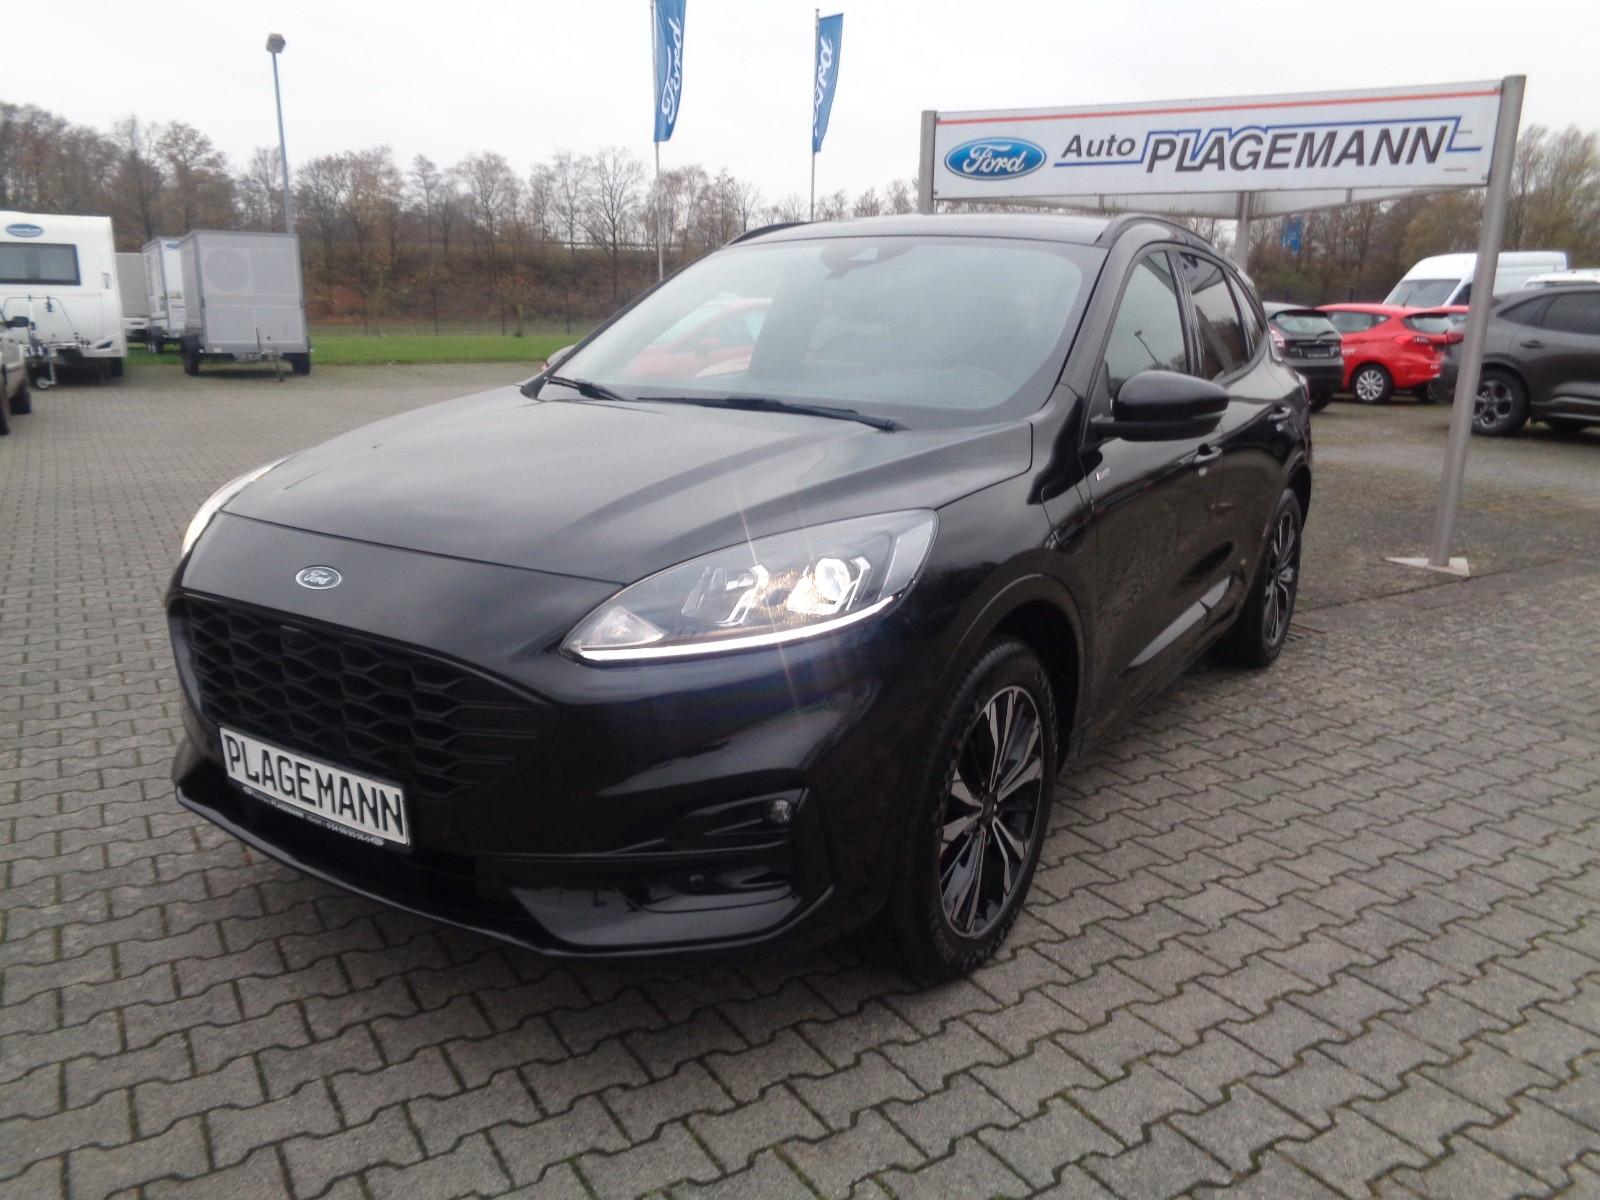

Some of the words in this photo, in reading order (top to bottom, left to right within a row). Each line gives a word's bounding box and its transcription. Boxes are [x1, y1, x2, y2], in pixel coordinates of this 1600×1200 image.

[661, 17, 681, 124] Ford
[962, 144, 1025, 174] Ford
[1061, 134, 1136, 158] Auto
[1146, 125, 1448, 174] PLAGEMANN
[303, 569, 332, 585] Ford
[223, 734, 405, 836] PLAGEMANN
